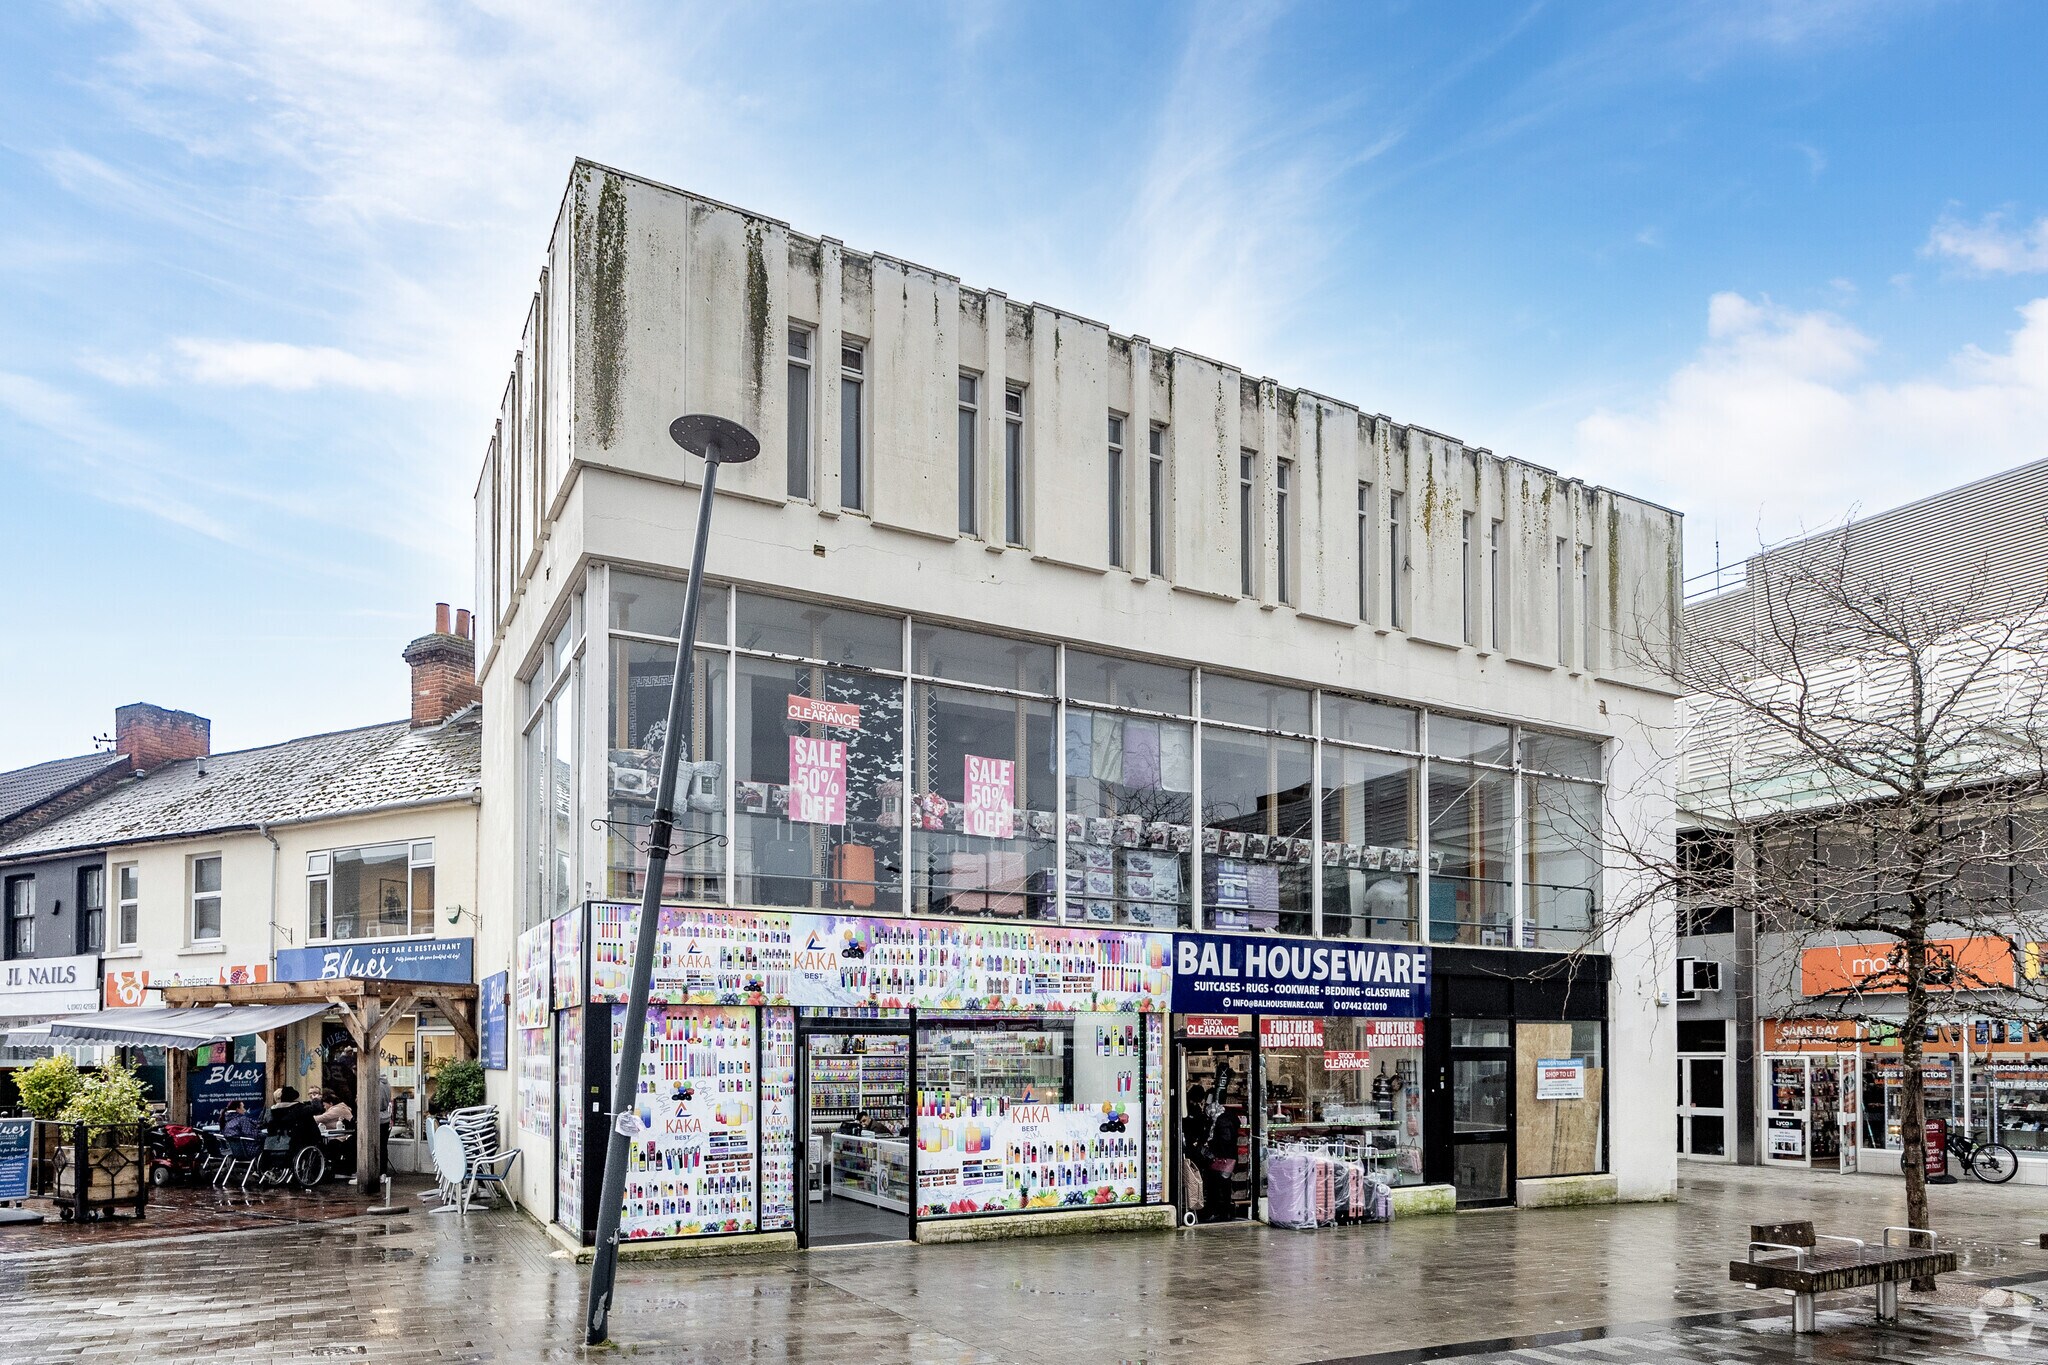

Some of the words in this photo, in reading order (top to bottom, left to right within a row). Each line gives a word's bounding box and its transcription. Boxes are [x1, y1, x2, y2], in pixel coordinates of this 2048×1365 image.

[810, 701, 837, 712] STOCK
[788, 705, 860, 727] CLEARANCE
[795, 738, 841, 768] SALE
[969, 757, 1010, 786] SALE
[797, 767, 839, 795] 50%
[971, 783, 1009, 811] 50%
[801, 793, 835, 821] OFF
[973, 809, 1004, 836] OFF
[371, 947, 389, 955] CAFE
[391, 946, 405, 954] BAR
[407, 945, 412, 953] &
[414, 942, 461, 953] RESTAURANT
[321, 948, 393, 980] Blues
[678, 954, 712, 969] KAKA
[793, 951, 838, 971] KAKA
[1177, 940, 1239, 976] BAL
[1245, 944, 1426, 984] HOUSEWARE
[6, 967, 22, 986] JL
[28, 965, 77, 985] NAILS
[804, 972, 824, 980] BEST
[1194, 981, 1241, 993] SUITCASES
[1245, 983, 1269, 994] RUGS
[1274, 984, 1320, 996] COOKWARE
[1325, 986, 1360, 997] BEDDING
[1365, 987, 1410, 998] GLASSWARE
[1232, 998, 1324, 1010] INFO@BALHOUSEWARE.CO.UK
[1341, 1001, 1362, 1010] 07442
[1362, 1001, 1387, 1011] 021010
[1202, 1018, 1223, 1026] STOCK
[1270, 1020, 1314, 1034] FURTHER
[1375, 1021, 1421, 1034] FURTHER
[1186, 1024, 1239, 1036] CLEARANCE
[1782, 1025, 1813, 1036] SAME
[1816, 1025, 1840, 1036] DAY
[1260, 1033, 1324, 1048] REDUCTIONS
[1366, 1034, 1424, 1048] REDUCTIONS
[1324, 1058, 1370, 1069] CLEARANCE
[205, 1064, 263, 1085] Blues
[765, 1116, 789, 1126] KAKA
[1012, 1106, 1050, 1124] KAKA
[665, 1118, 702, 1134] KAKA
[1021, 1125, 1038, 1133] BEST
